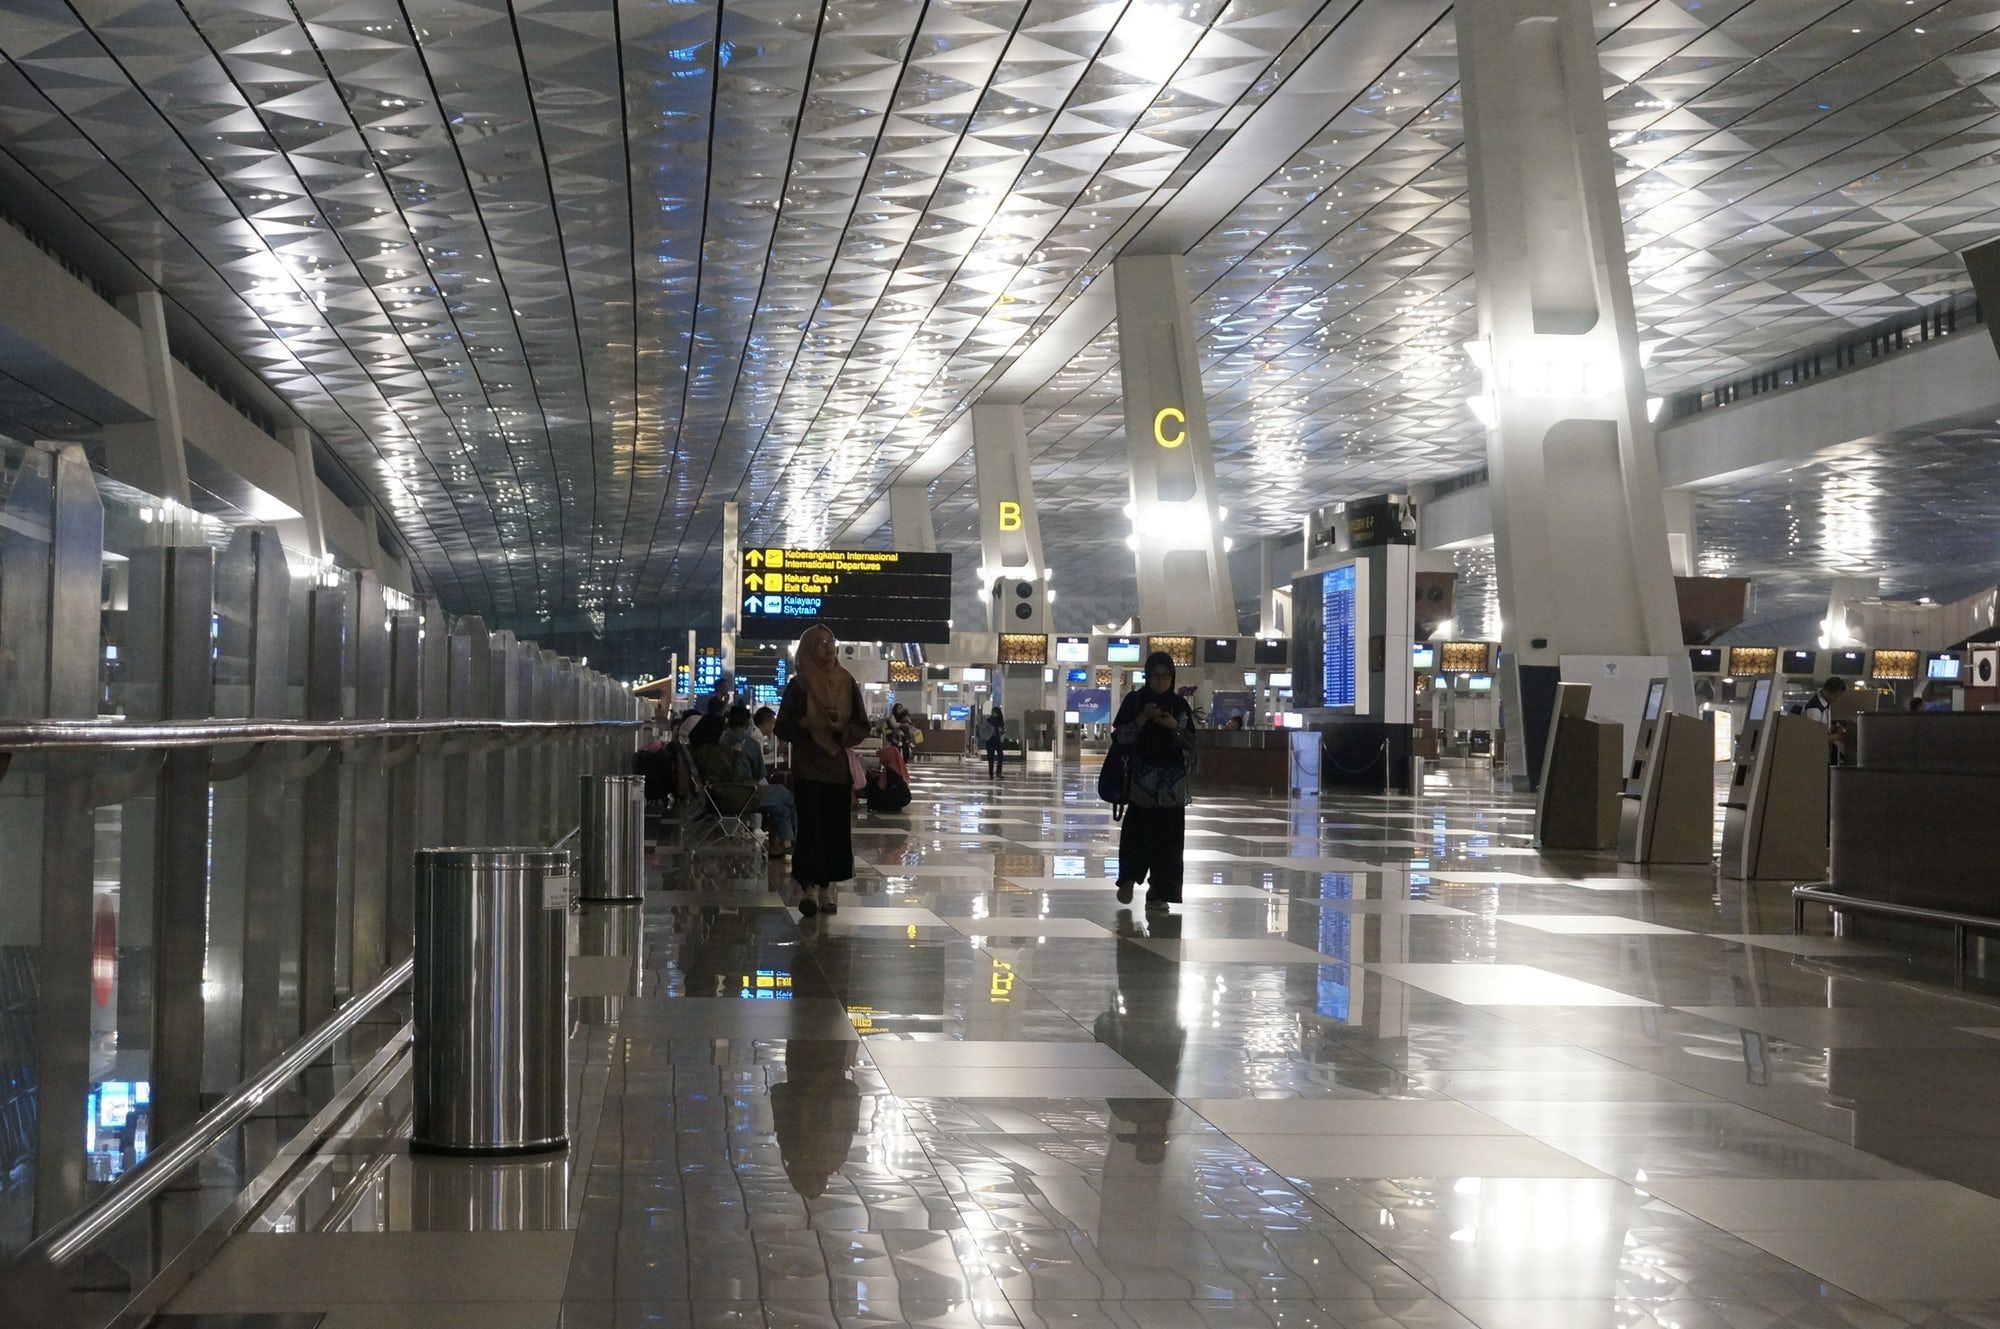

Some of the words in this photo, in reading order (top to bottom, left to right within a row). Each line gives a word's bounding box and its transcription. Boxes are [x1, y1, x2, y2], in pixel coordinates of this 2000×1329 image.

[1153, 407, 1185, 449] C
[999, 501, 1021, 531] B
[784, 550, 845, 561] Keberangkatan
[847, 552, 898, 561] Internasional
[784, 560, 835, 569] International
[836, 561, 881, 571] Departures
[784, 573, 811, 583] Keluar
[812, 574, 832, 584] Gate
[834, 574, 839, 584] 1
[784, 583, 800, 592] Exit
[801, 583, 822, 593] Gate
[823, 584, 828, 593] 1
[784, 595, 821, 607] Kalayang
[783, 605, 817, 616] Skytrain
